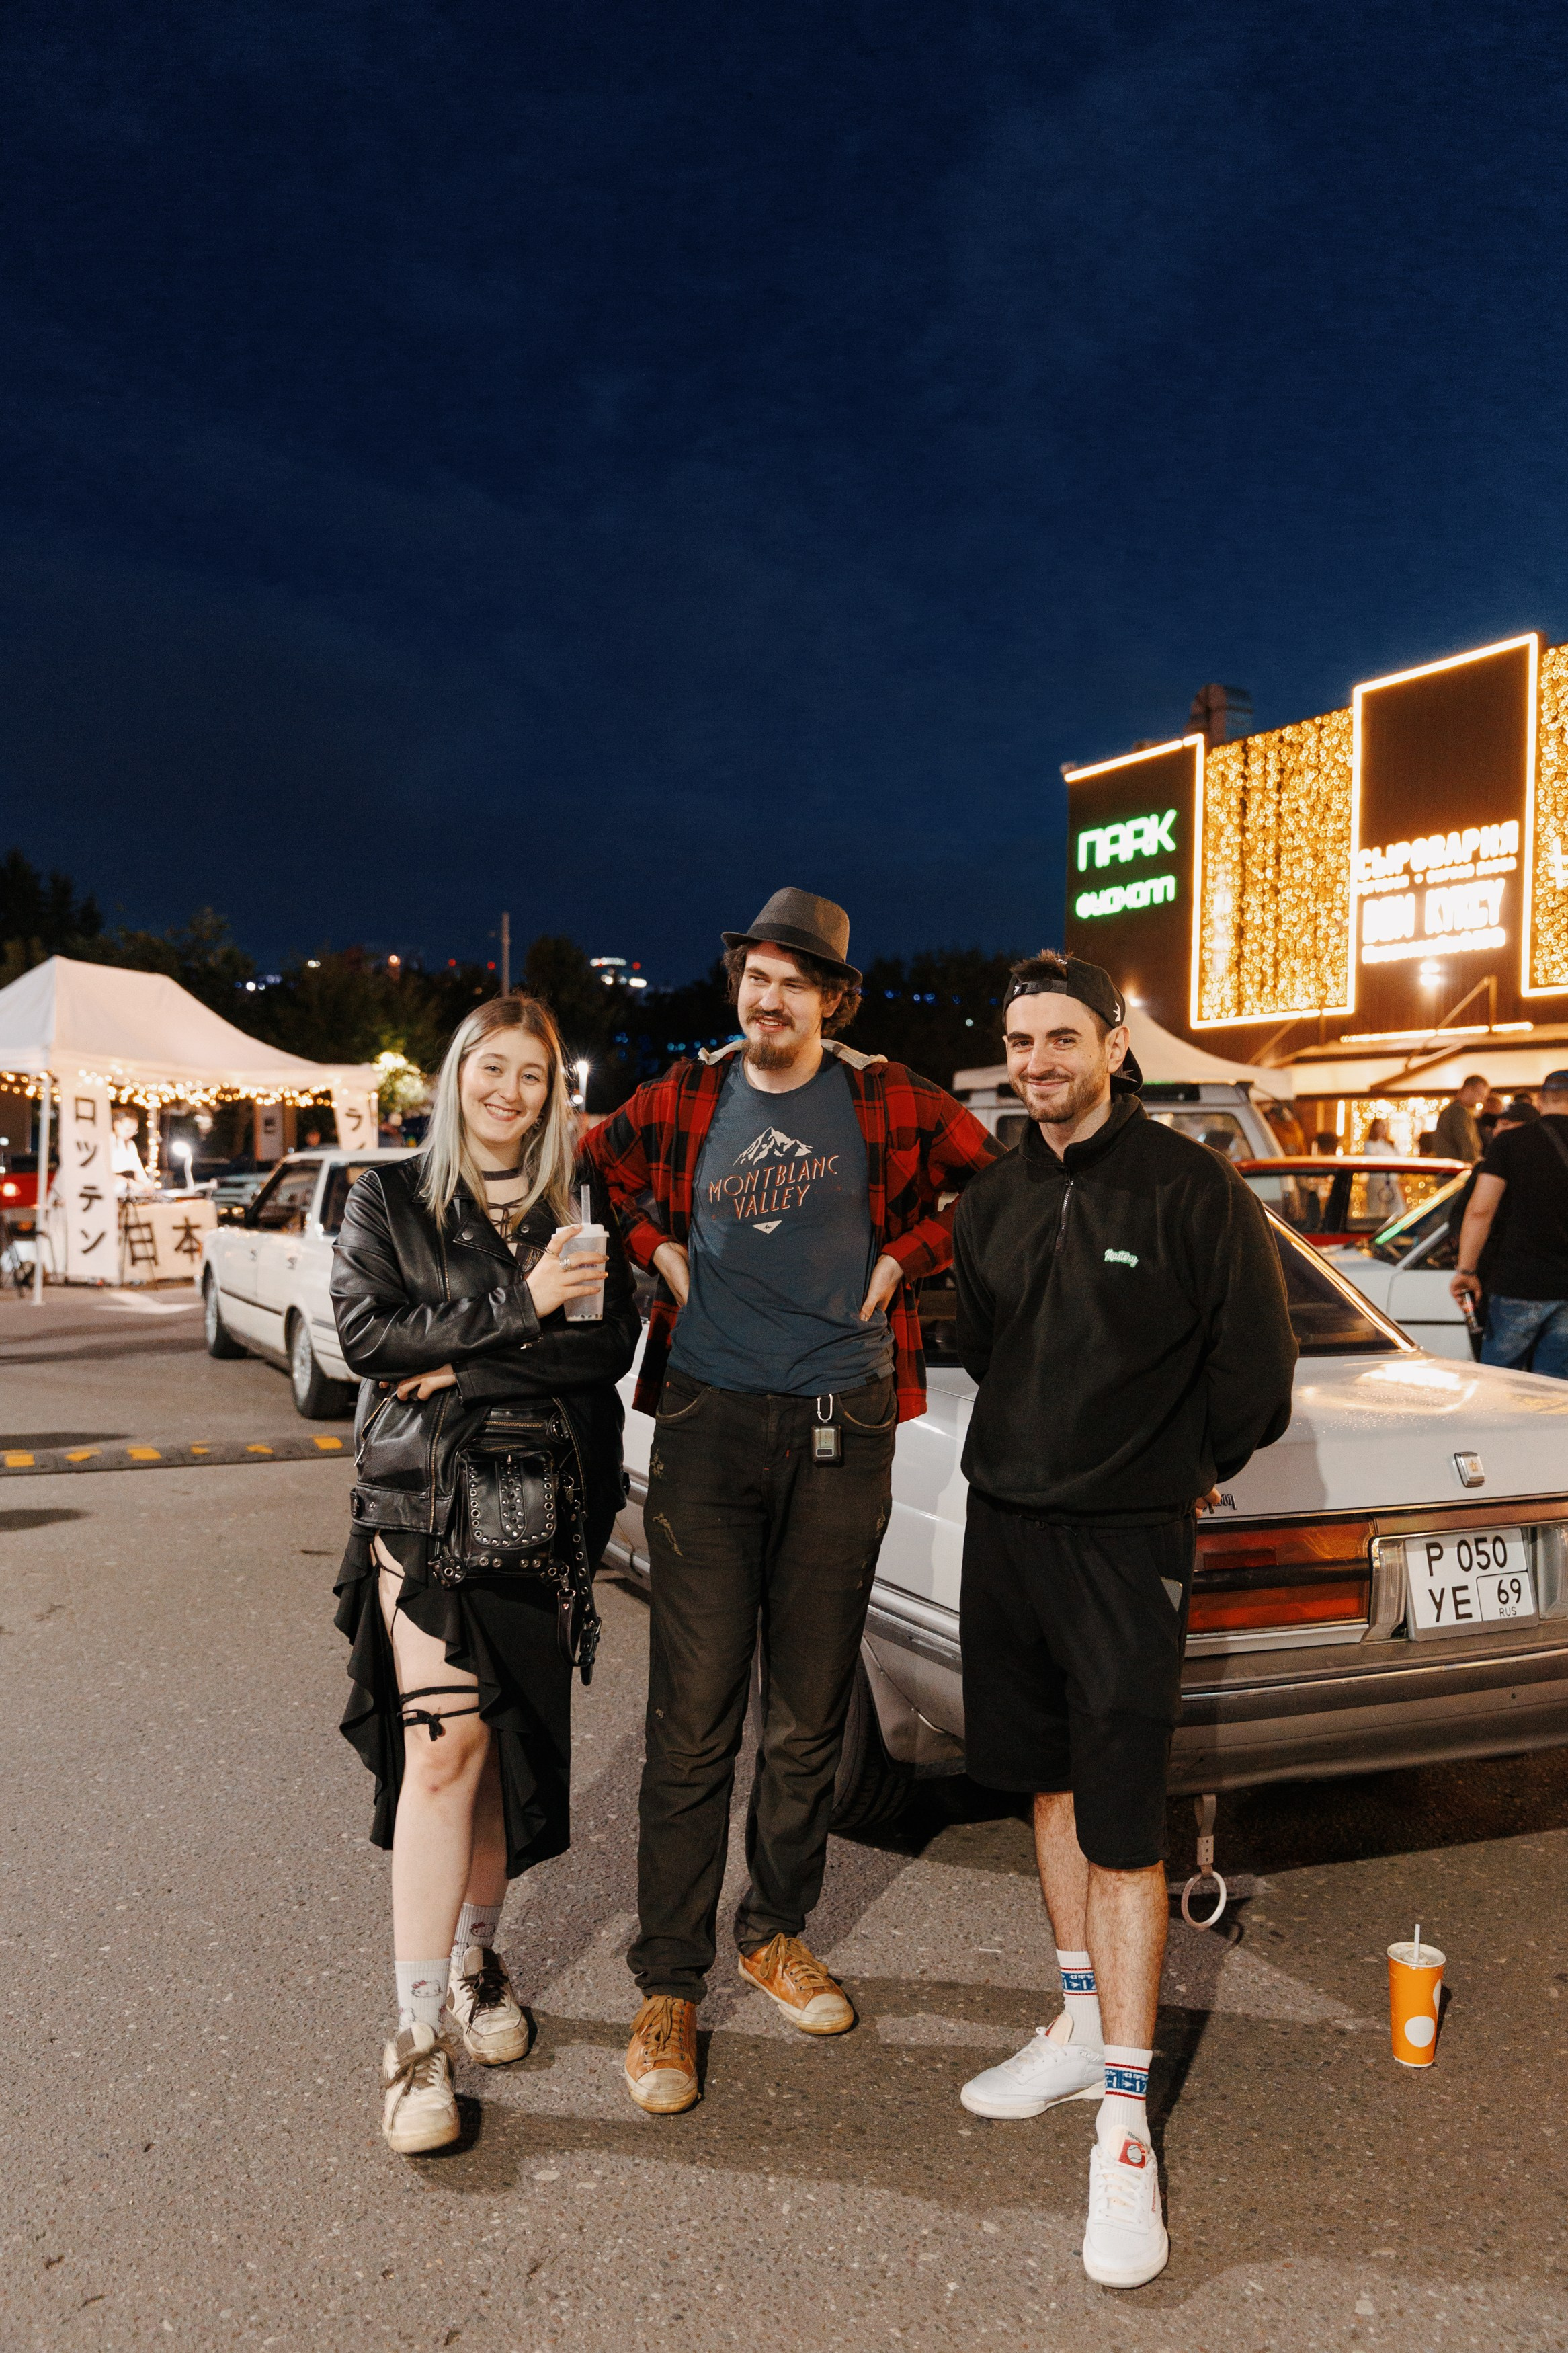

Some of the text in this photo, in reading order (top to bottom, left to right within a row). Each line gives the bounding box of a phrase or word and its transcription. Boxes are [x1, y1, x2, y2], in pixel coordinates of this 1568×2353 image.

[1078, 809, 1177, 871] ПАРК
[709, 1154, 839, 1203] MONTBLANC
[733, 1184, 811, 1220] VALLEY
[1456, 1535, 1507, 1572] 050
[1497, 1578, 1521, 1605] 69
[1499, 1606, 1517, 1618] RUS
